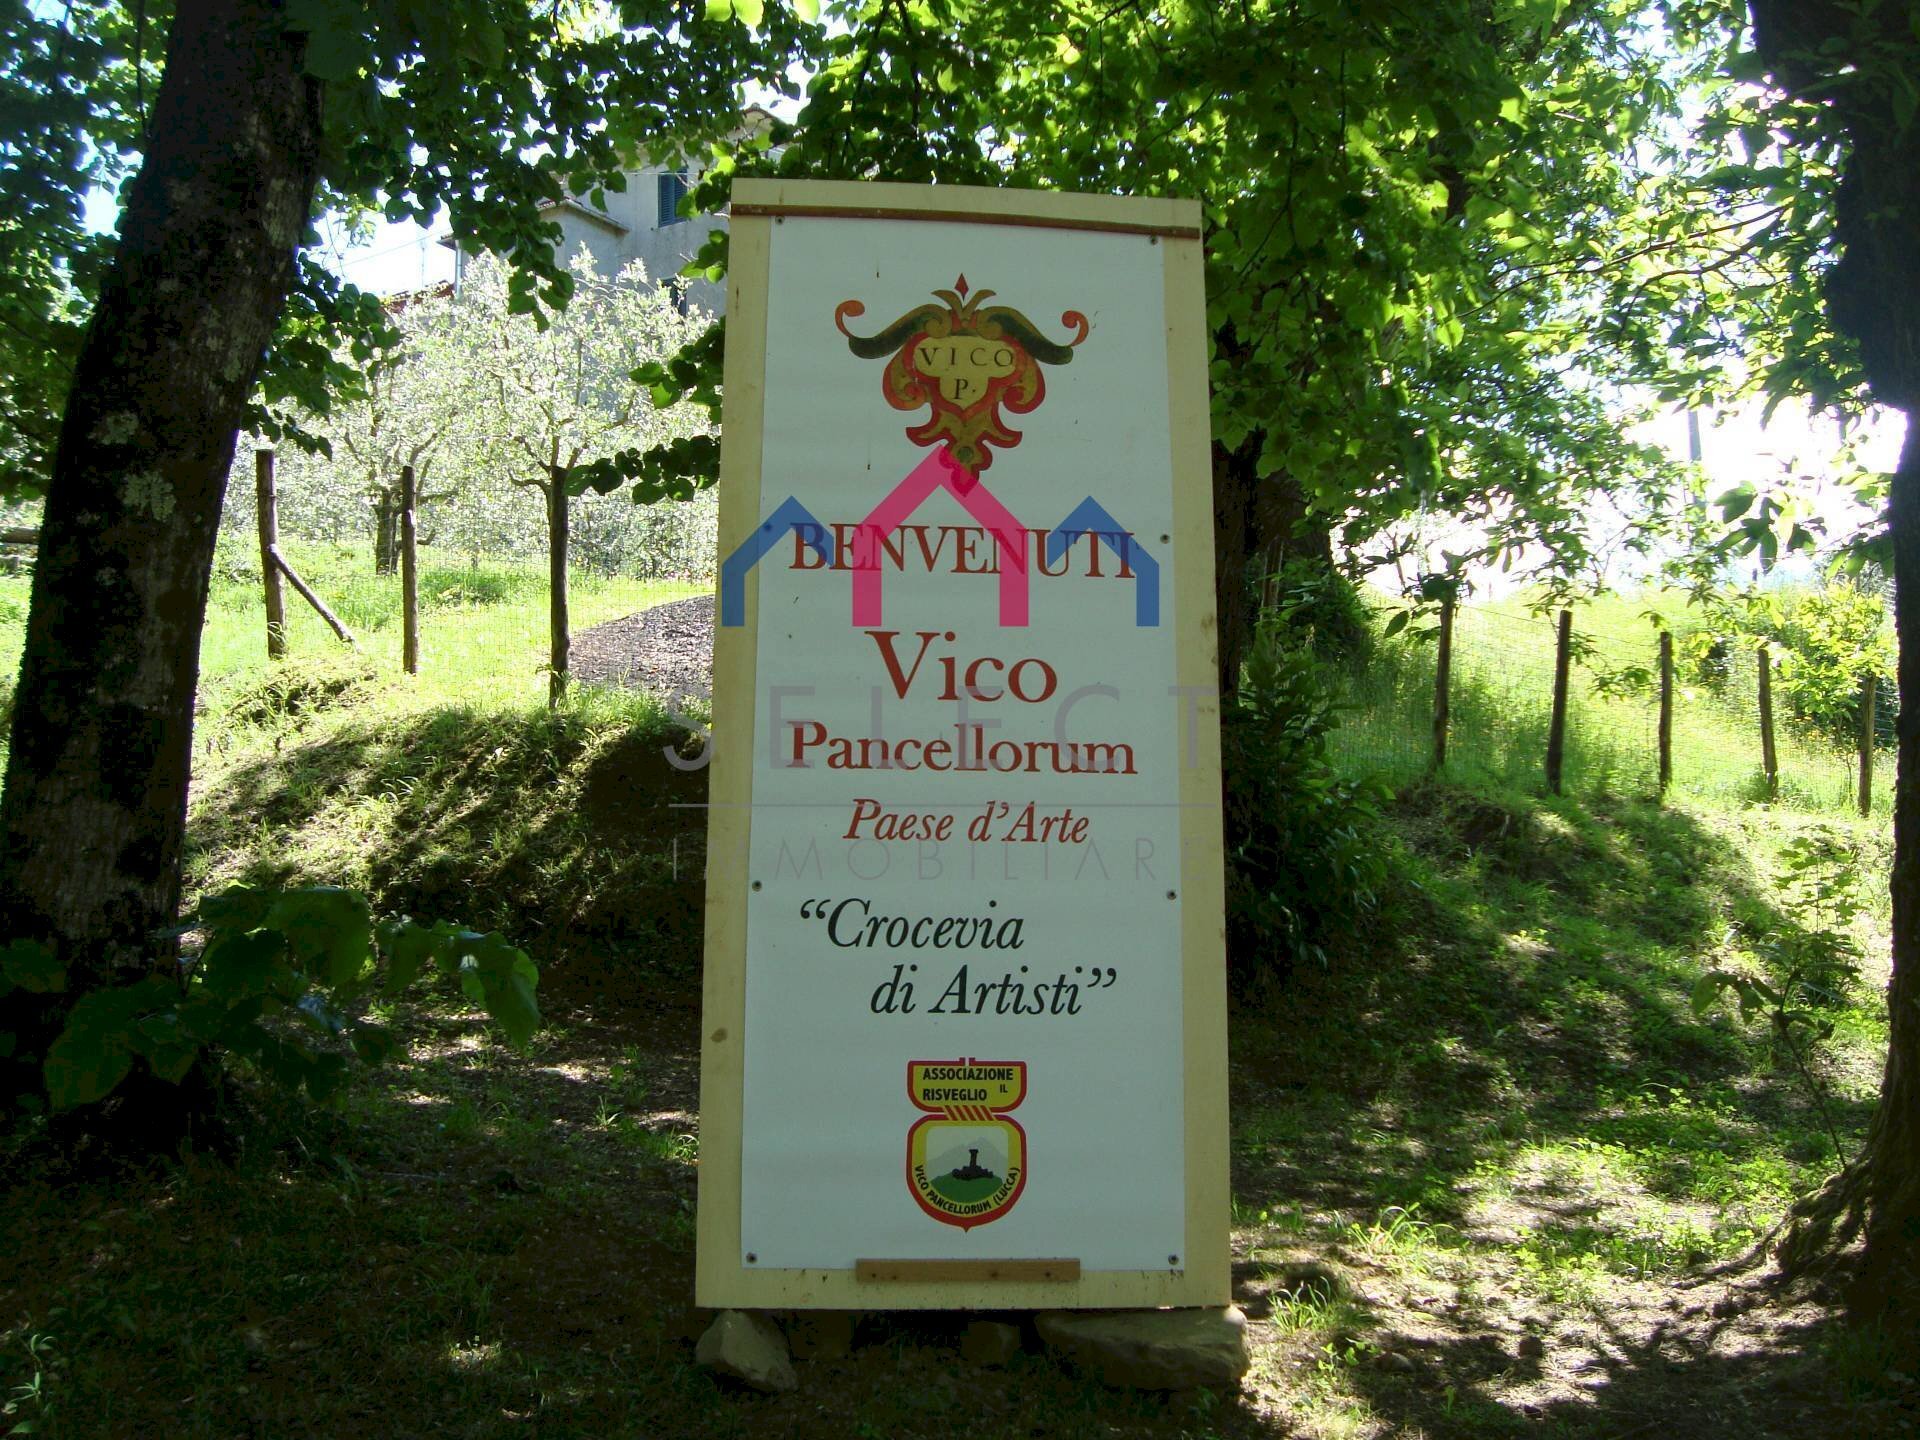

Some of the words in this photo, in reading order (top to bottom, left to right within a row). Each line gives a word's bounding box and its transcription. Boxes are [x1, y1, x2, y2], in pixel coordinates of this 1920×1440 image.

[919, 347, 1014, 367] VICO
[789, 522, 1139, 579] BENVENUTI
[864, 631, 1058, 703] Vico
[786, 720, 1138, 775] Pancellorum
[842, 798, 954, 842] Paese
[870, 964, 917, 1014] di
[923, 1068, 1014, 1081] ASSOCIAZIONE
[923, 1088, 988, 1101] RISVEGLIO
[999, 1084, 1009, 1094] IL
[914, 1164, 929, 1191] VICO
[926, 1190, 992, 1215] PANCELLORUM
[993, 1167, 1021, 1206] (LUCCA)
